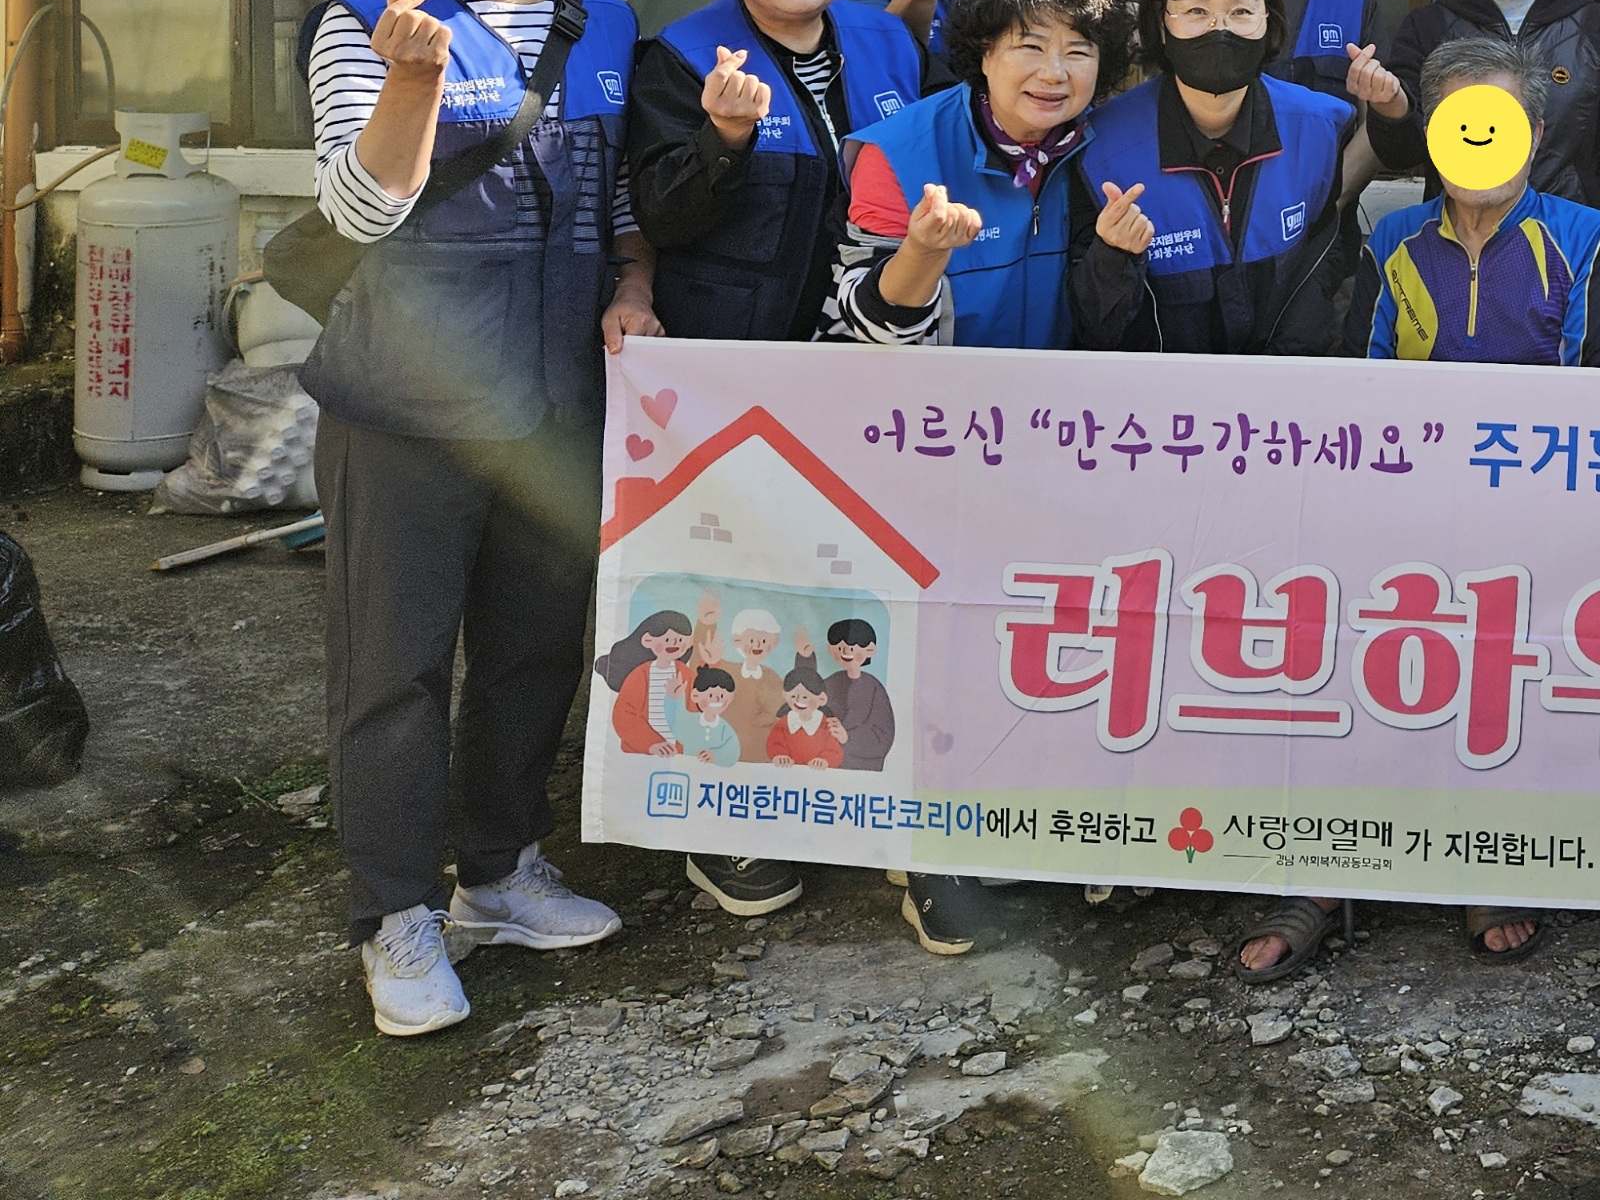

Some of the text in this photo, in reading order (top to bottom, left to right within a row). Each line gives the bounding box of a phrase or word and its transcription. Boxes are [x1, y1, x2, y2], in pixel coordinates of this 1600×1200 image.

[443, 76, 506, 94] 국지엠 법우회
[1148, 228, 1202, 249] 국지엠 법우회
[863, 406, 1004, 466] 어르신
[697, 780, 1038, 840] 지엠한마음재단코리아에서
[1049, 808, 1158, 845] 후원하고
[1223, 814, 1394, 852] 사랑의열매
[1405, 828, 1432, 863] 가
[1444, 830, 1594, 869] 지원합니다.
[1275, 853, 1393, 871] 경남 사회복지공동모금회
